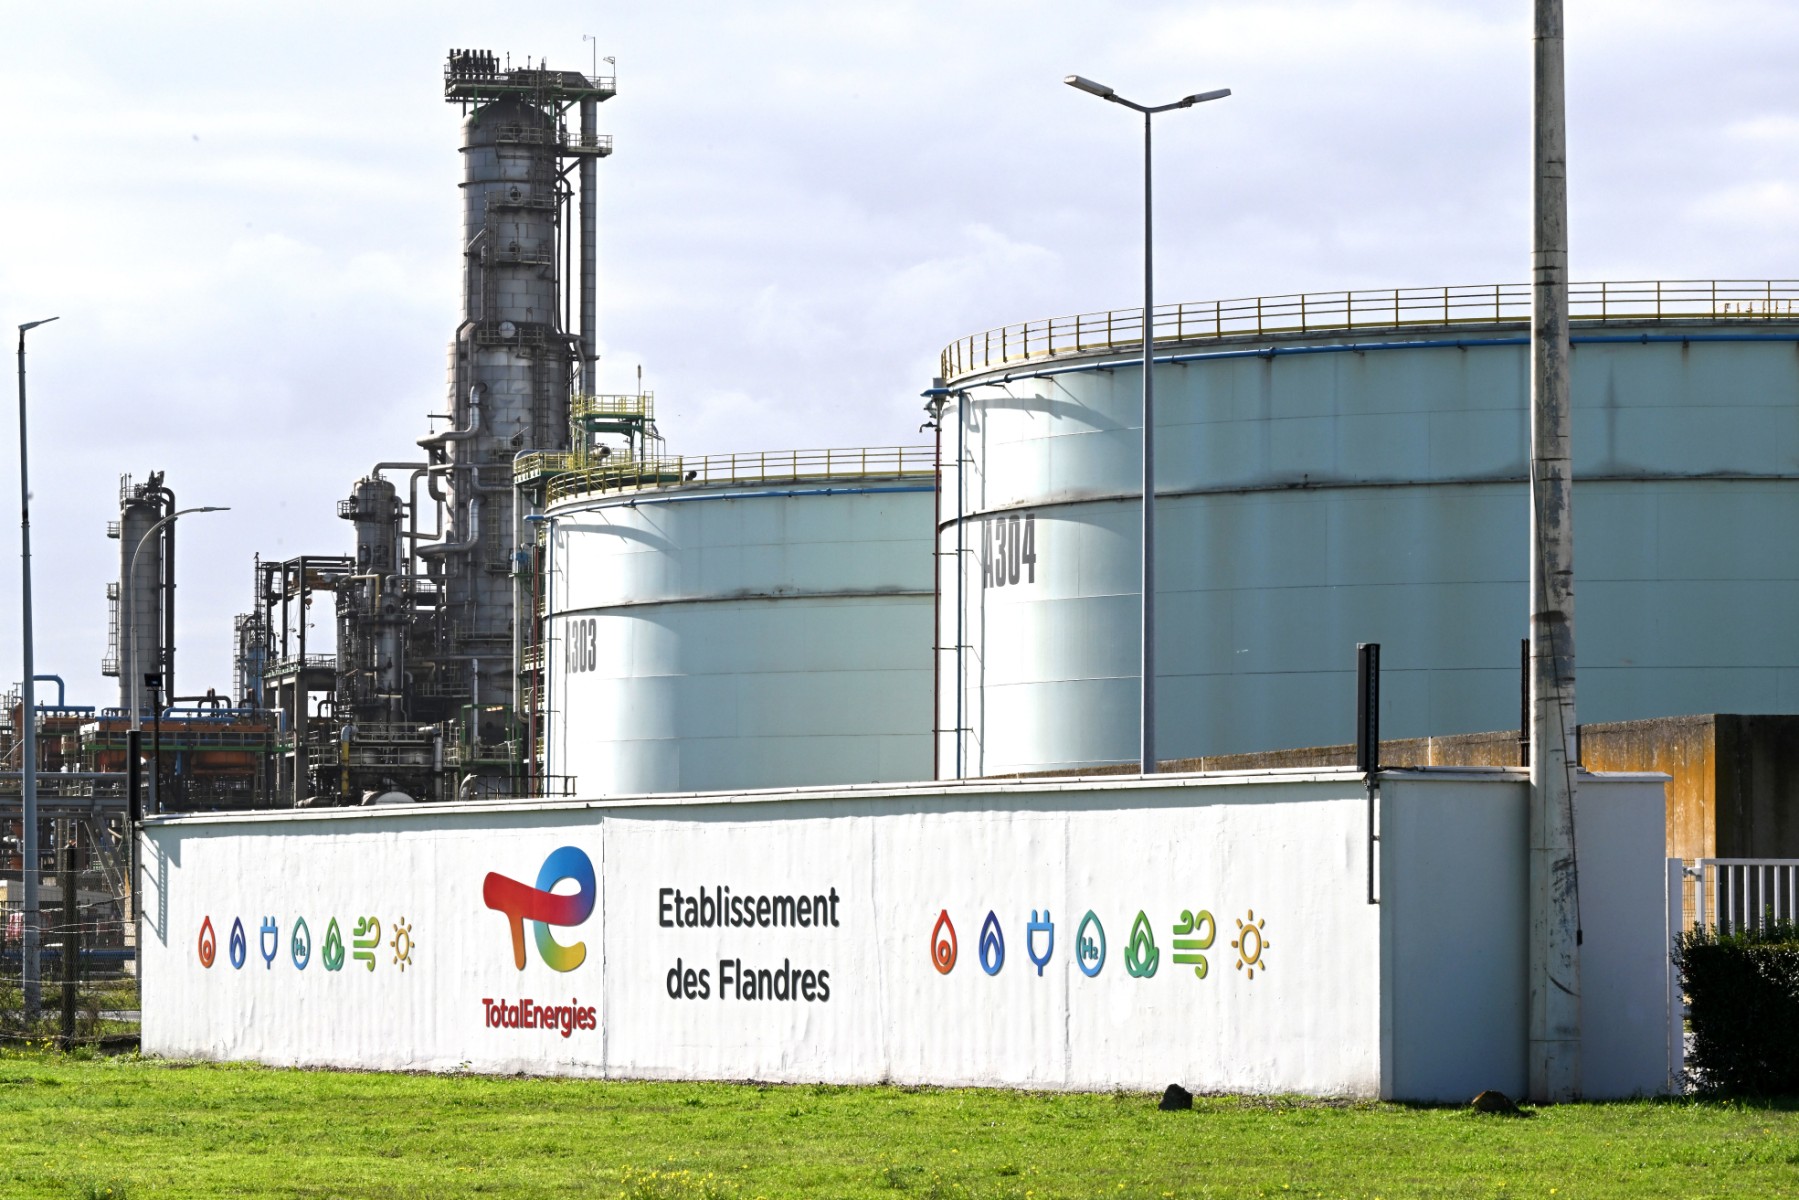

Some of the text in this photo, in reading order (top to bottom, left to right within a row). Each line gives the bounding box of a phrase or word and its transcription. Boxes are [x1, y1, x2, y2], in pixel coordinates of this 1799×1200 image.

[983, 514, 1036, 588] A304
[659, 885, 840, 928] Etablissement
[666, 957, 830, 1002] des Flandres
[482, 997, 596, 1038] TotalEnergies
